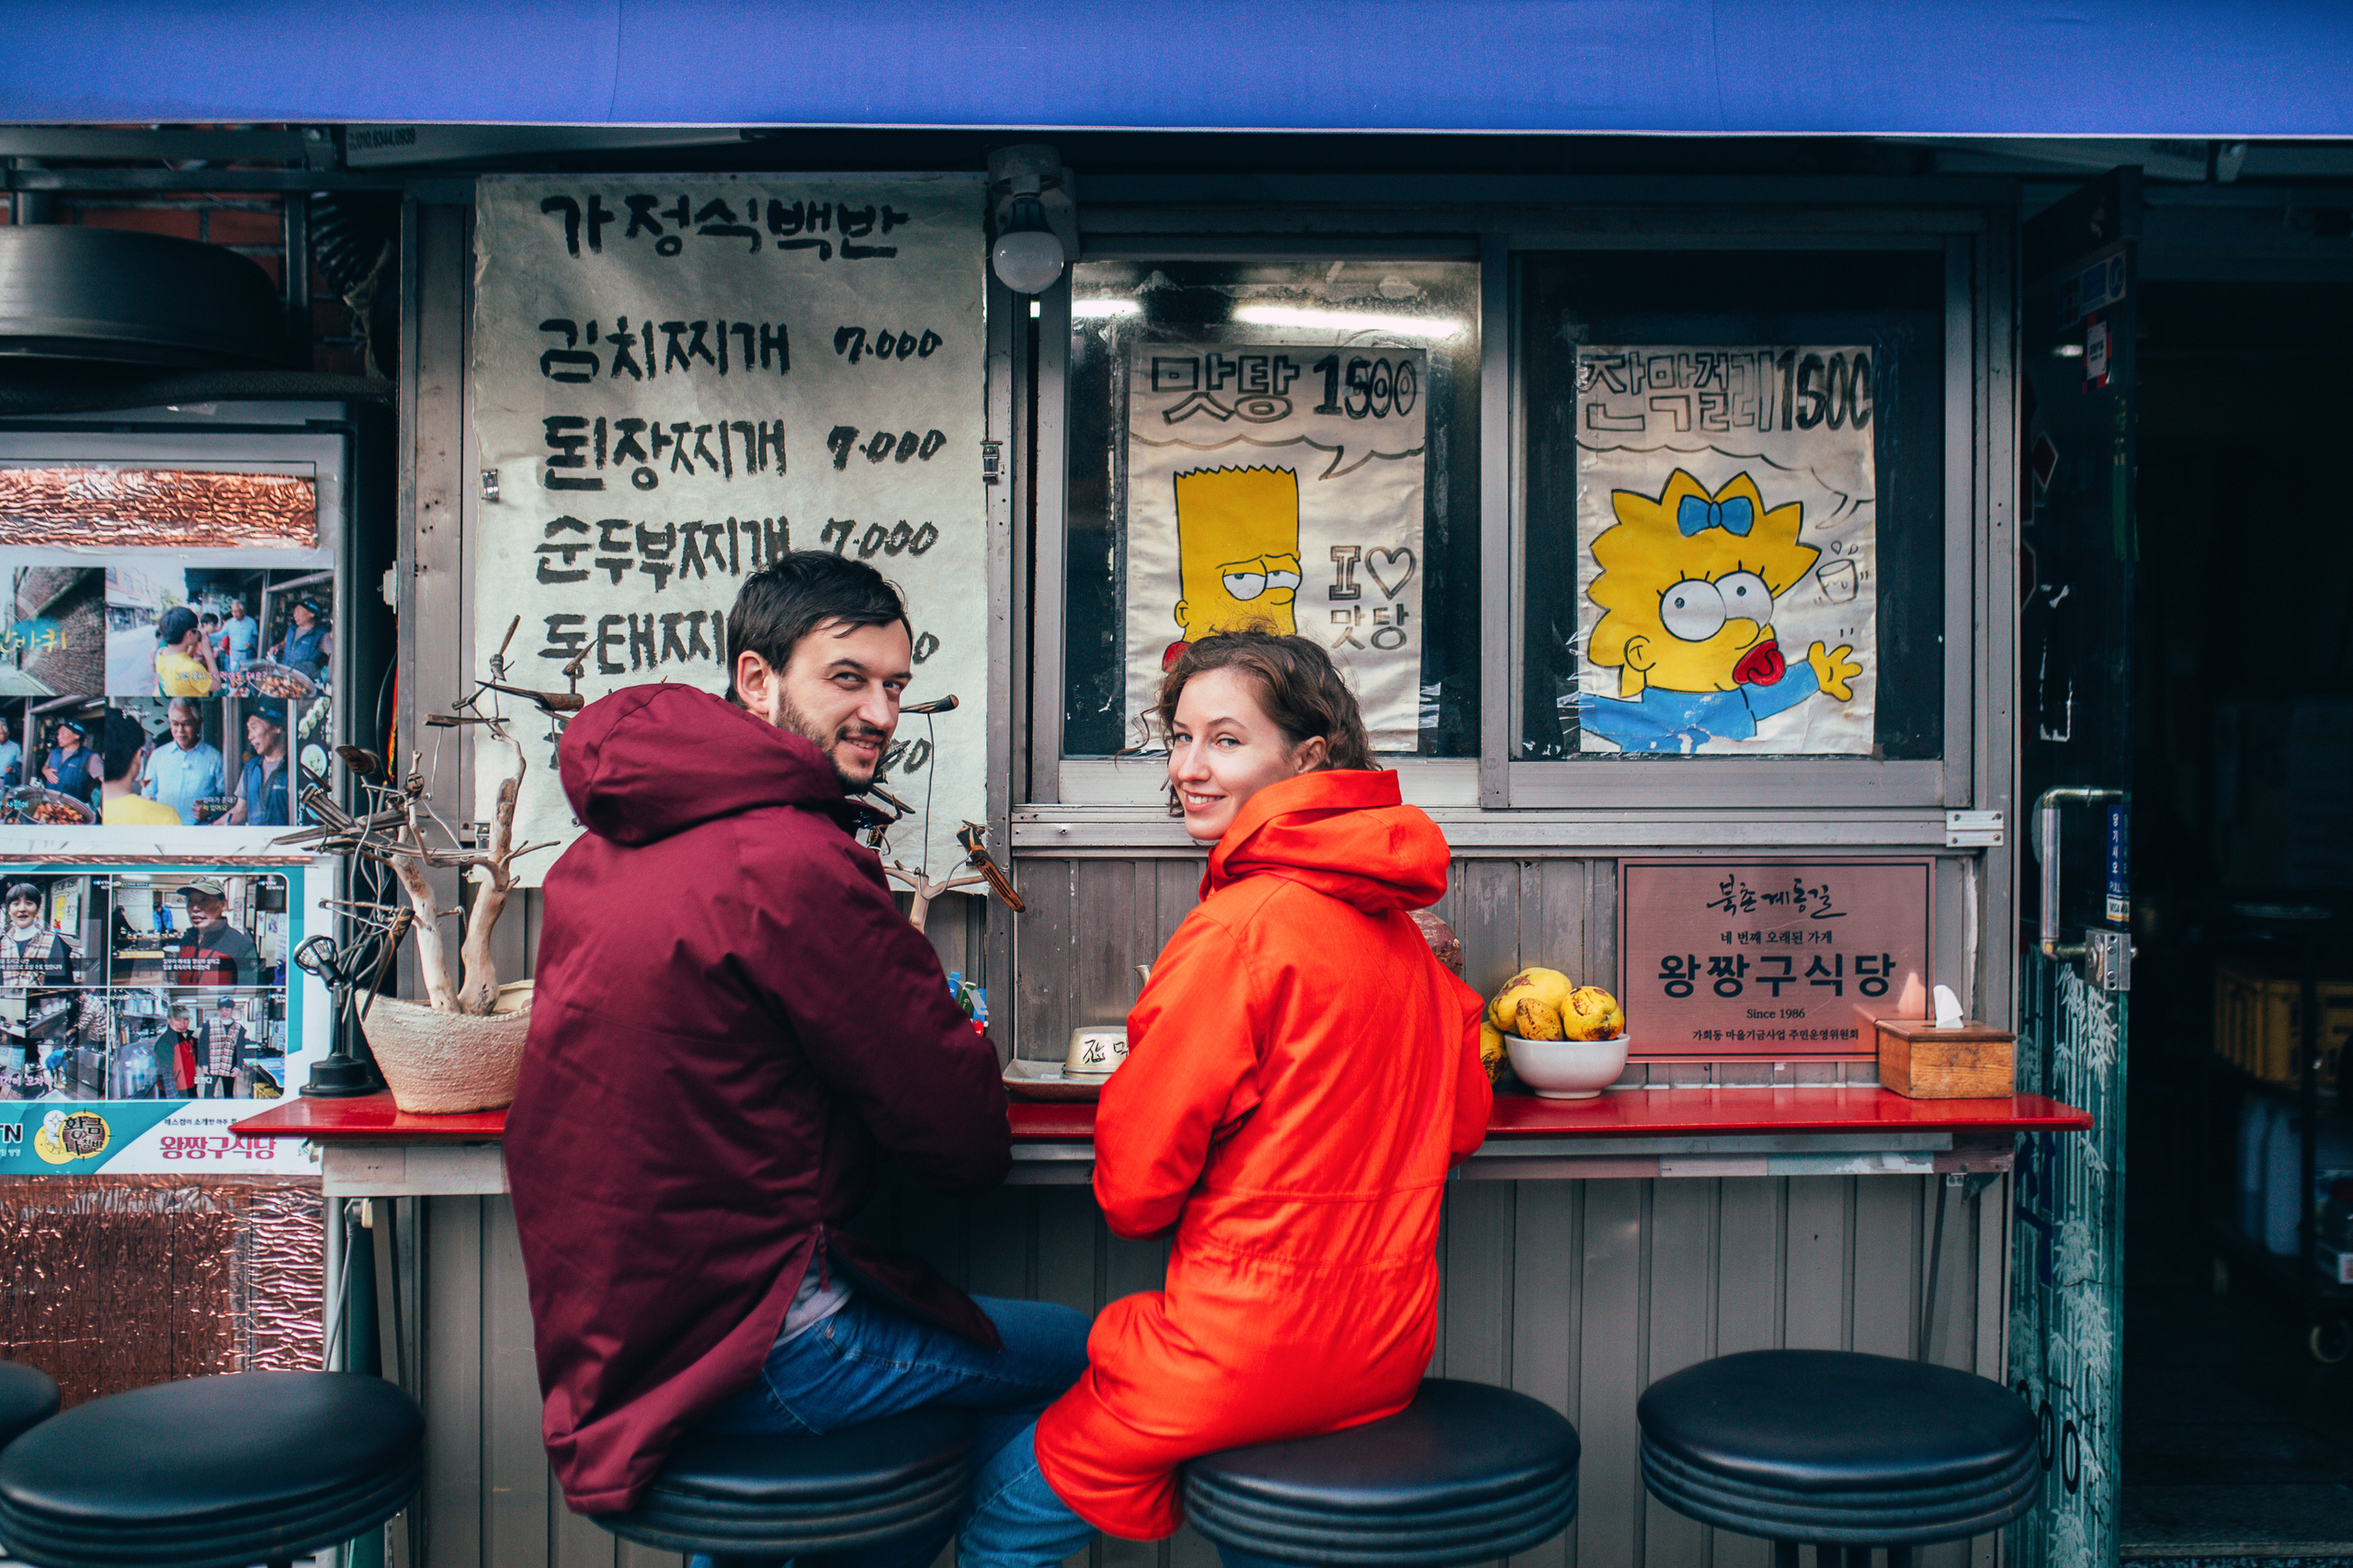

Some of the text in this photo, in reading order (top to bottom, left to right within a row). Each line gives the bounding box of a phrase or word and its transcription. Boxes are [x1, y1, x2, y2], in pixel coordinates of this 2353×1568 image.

[540, 194, 910, 261] 가정식백반
[540, 315, 943, 383] 김치찌개 7.000
[1152, 353, 1417, 426] 맛탕 1500
[1577, 349, 1873, 433] 잔막걸리 1500
[542, 415, 948, 492] 된장찌개 7.000
[533, 515, 939, 593] 순두부찌개 7.000
[538, 609, 726, 682] 동태찌
[1330, 603, 1410, 652] 맛탕
[1720, 930, 1833, 945] 네 번째 오래된 가게
[1658, 952, 1897, 998] 왕짱구식당
[1692, 1028, 1859, 1040] 가회동 마을기금사업 주민운영위원회
[1745, 1007, 1806, 1019] Since 1986
[160, 1136, 278, 1160] 왕짱구식당
